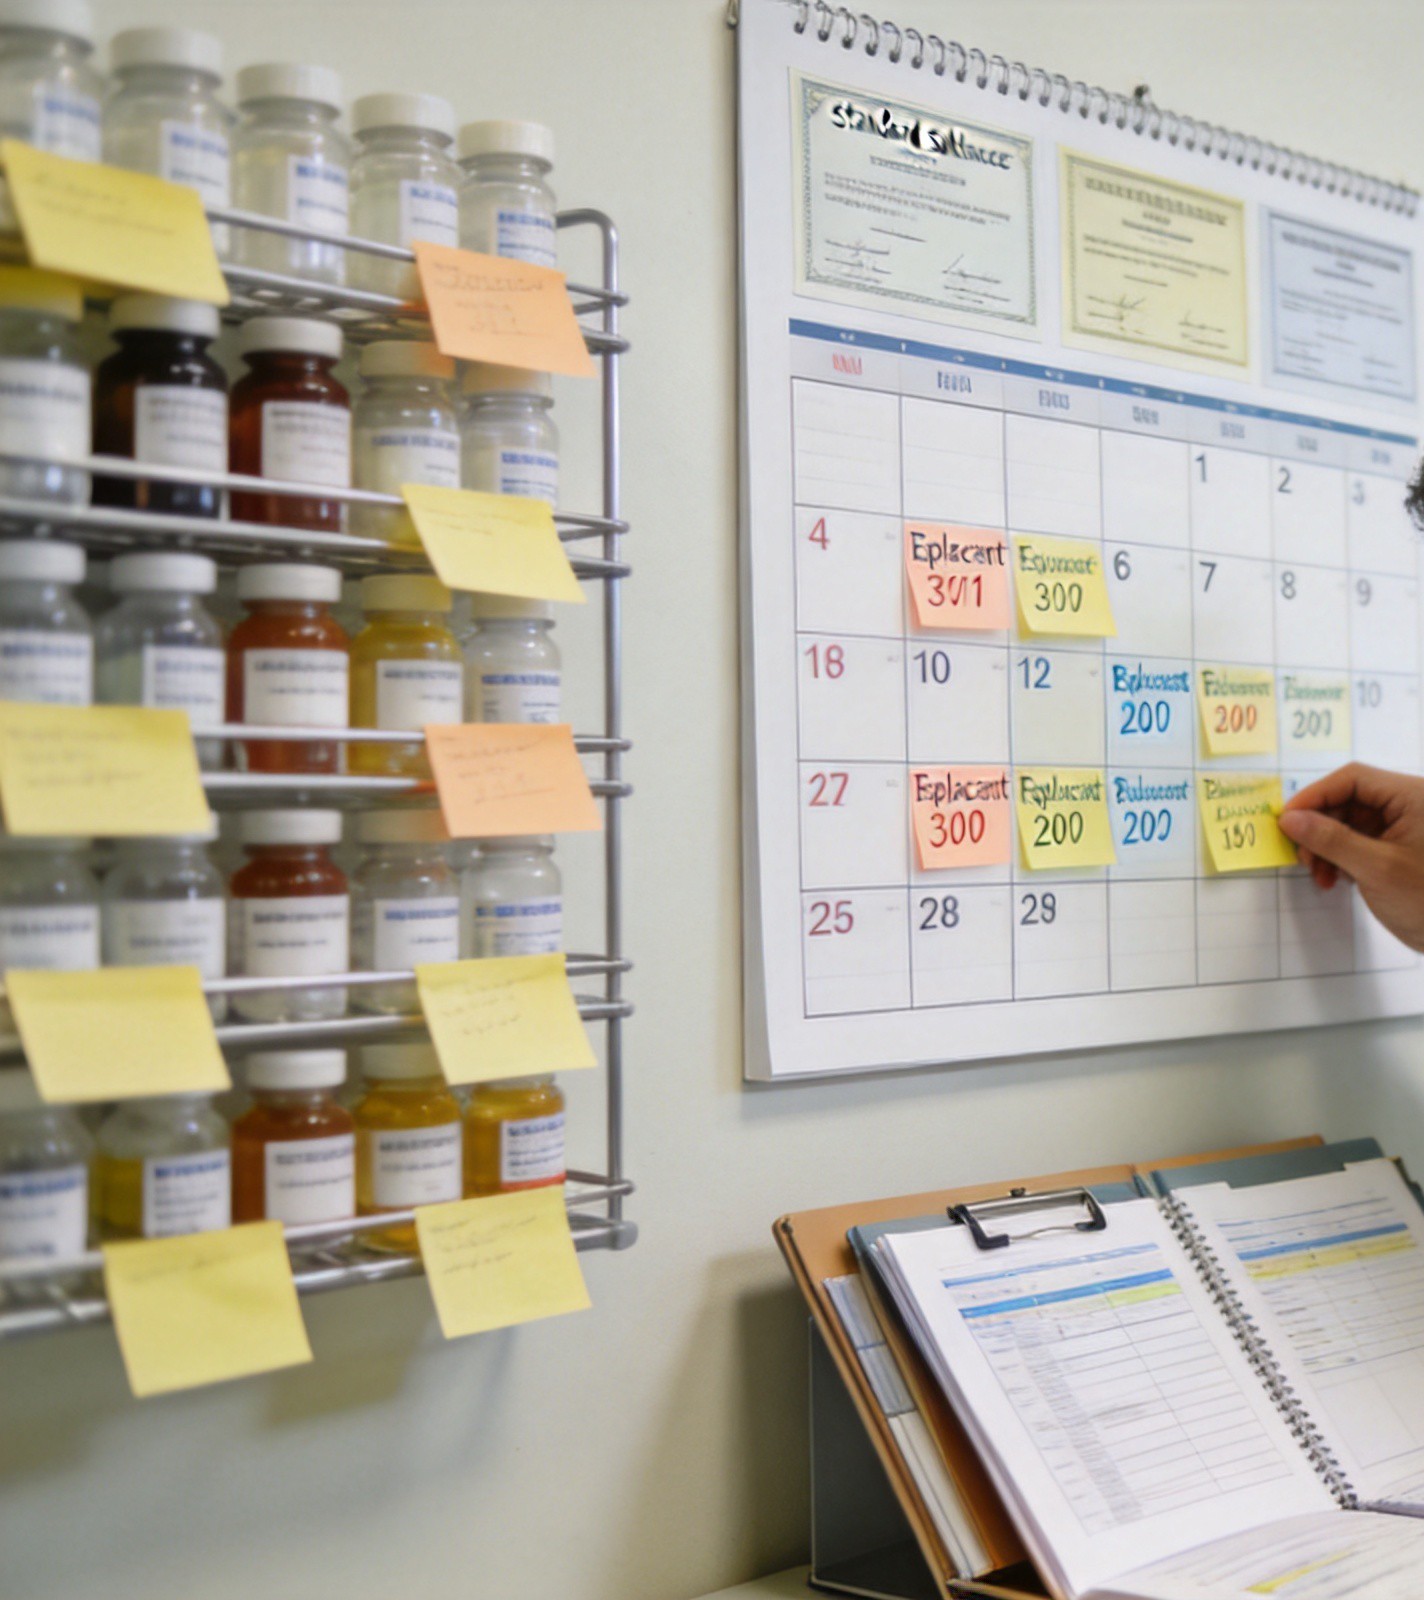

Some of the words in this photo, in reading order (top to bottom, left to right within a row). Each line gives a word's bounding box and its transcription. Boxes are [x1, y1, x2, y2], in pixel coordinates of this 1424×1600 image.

[1195, 454, 1208, 483] 1
[1277, 466, 1292, 494] 2
[808, 517, 830, 551] 4
[1113, 550, 1131, 581] 6
[1199, 560, 1217, 592] 7
[1035, 582, 1083, 613] 300
[1280, 571, 1297, 600] 8
[1355, 578, 1372, 607] 9
[804, 643, 845, 680] 18
[913, 650, 951, 684] 10
[1017, 656, 1052, 690] 12
[1119, 700, 1171, 735] 200
[1214, 704, 1258, 734] 200
[808, 772, 850, 807] 27
[929, 809, 986, 848] 300
[1033, 811, 1084, 847] 200
[1122, 808, 1173, 845] 200
[808, 900, 854, 936] 25
[919, 895, 960, 931] 28
